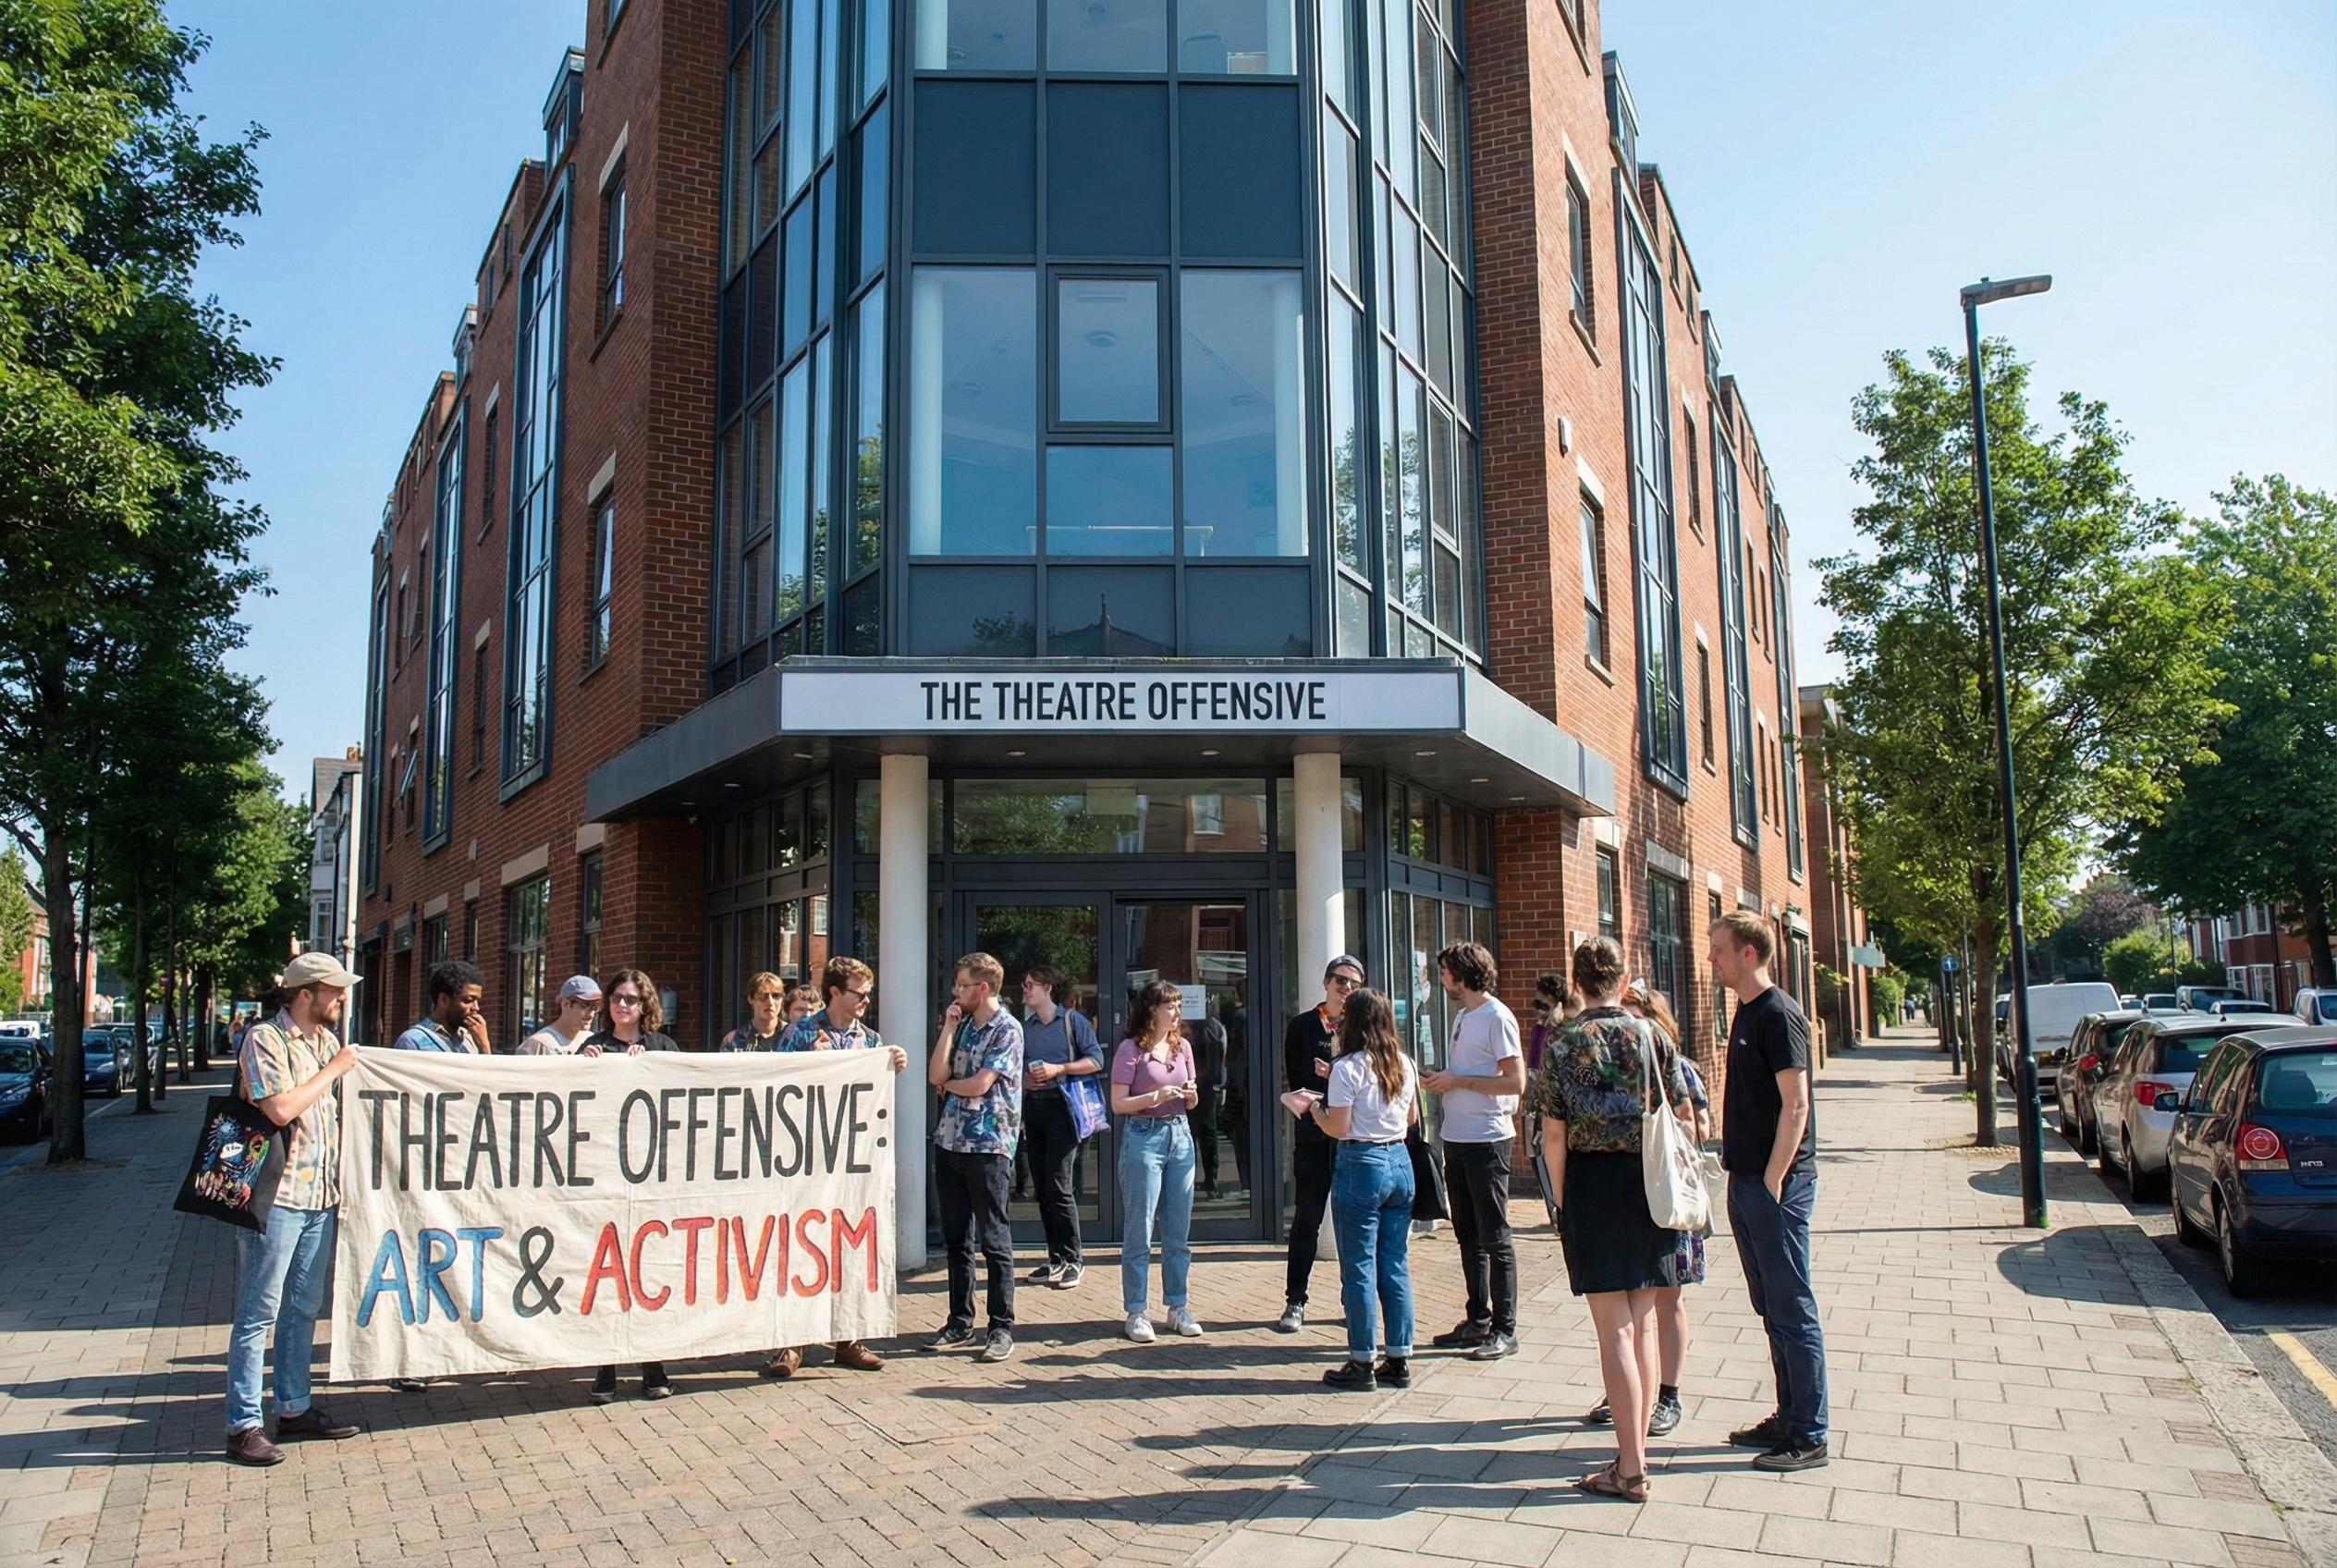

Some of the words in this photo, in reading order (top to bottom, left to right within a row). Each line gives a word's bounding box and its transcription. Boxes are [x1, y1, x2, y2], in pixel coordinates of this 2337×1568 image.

[921, 681, 982, 720] THE
[992, 681, 1136, 720] THEATRE
[1148, 681, 1326, 720] OFFENSIVE
[358, 1090, 596, 1192] THEATRE
[618, 1083, 887, 1184] OFFENSIVE:
[356, 1226, 505, 1329] ART
[512, 1225, 564, 1317] &
[580, 1206, 879, 1316] ACTIVISM
